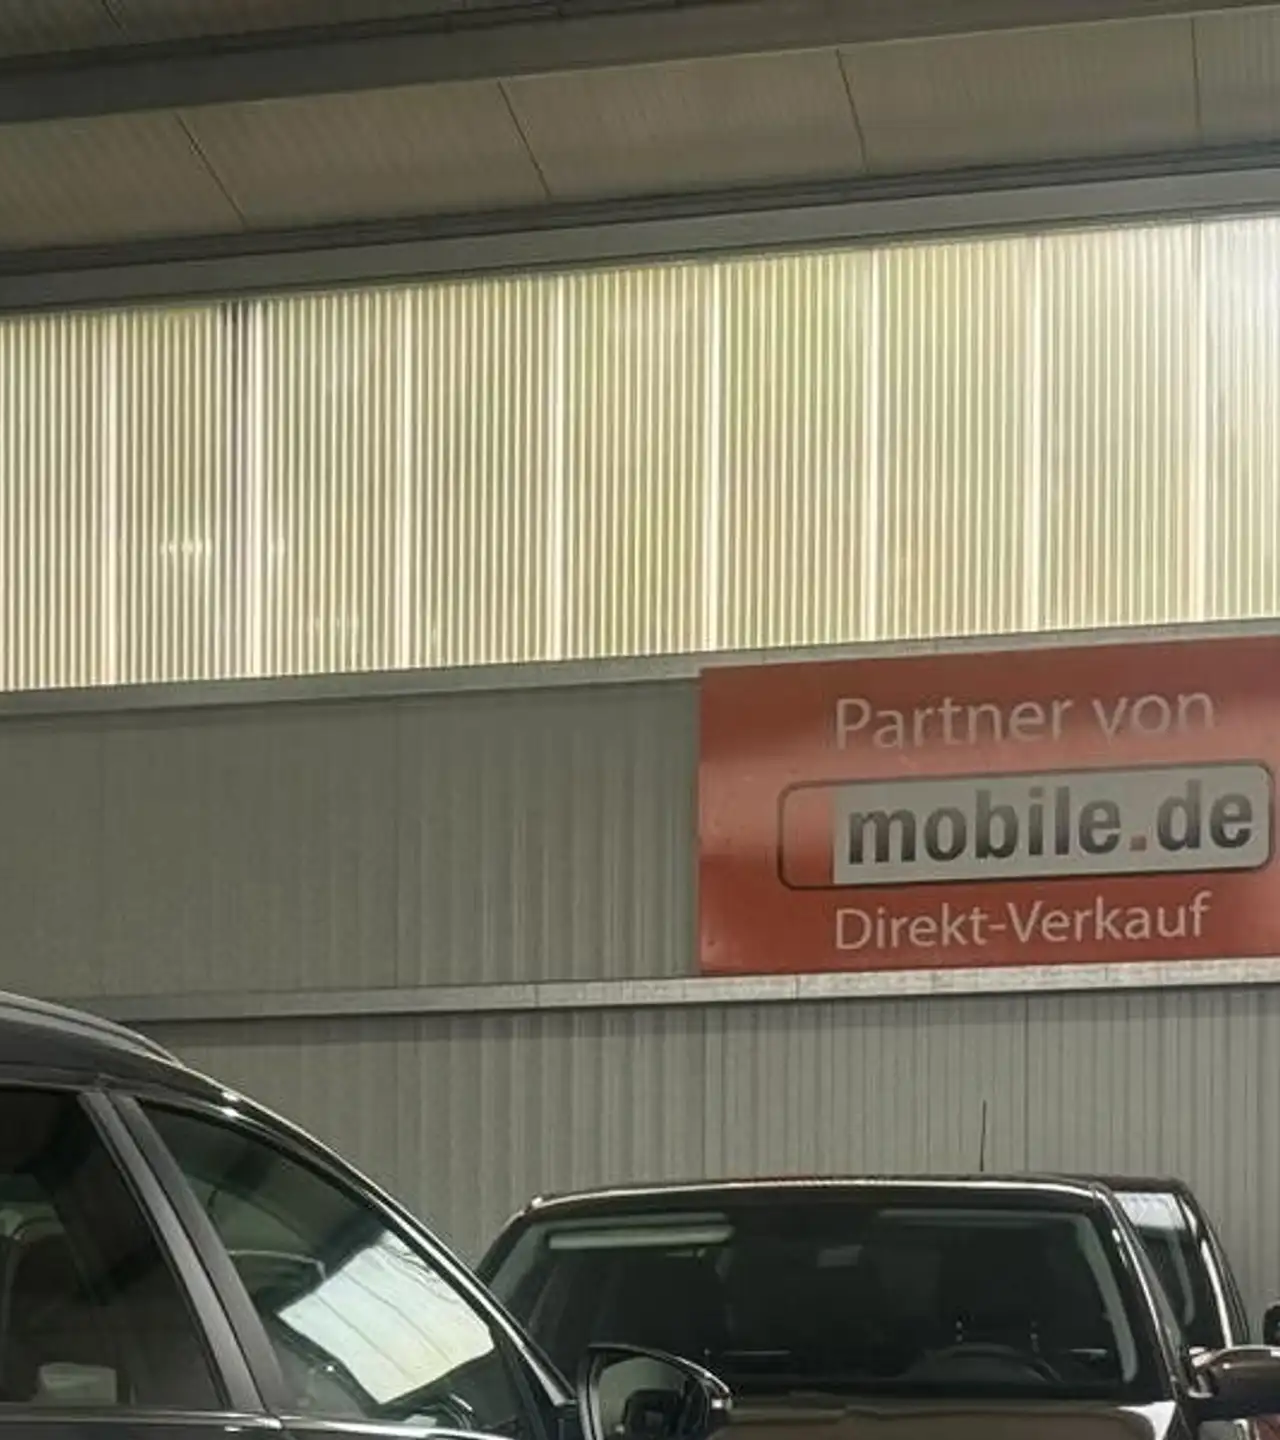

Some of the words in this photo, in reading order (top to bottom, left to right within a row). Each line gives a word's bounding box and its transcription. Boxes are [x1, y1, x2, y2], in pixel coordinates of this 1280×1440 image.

[836, 693, 1073, 750] Partner
[1092, 691, 1214, 742] von
[847, 778, 1254, 865] mobile.de
[835, 891, 1212, 950] Direkt-Verkauf
